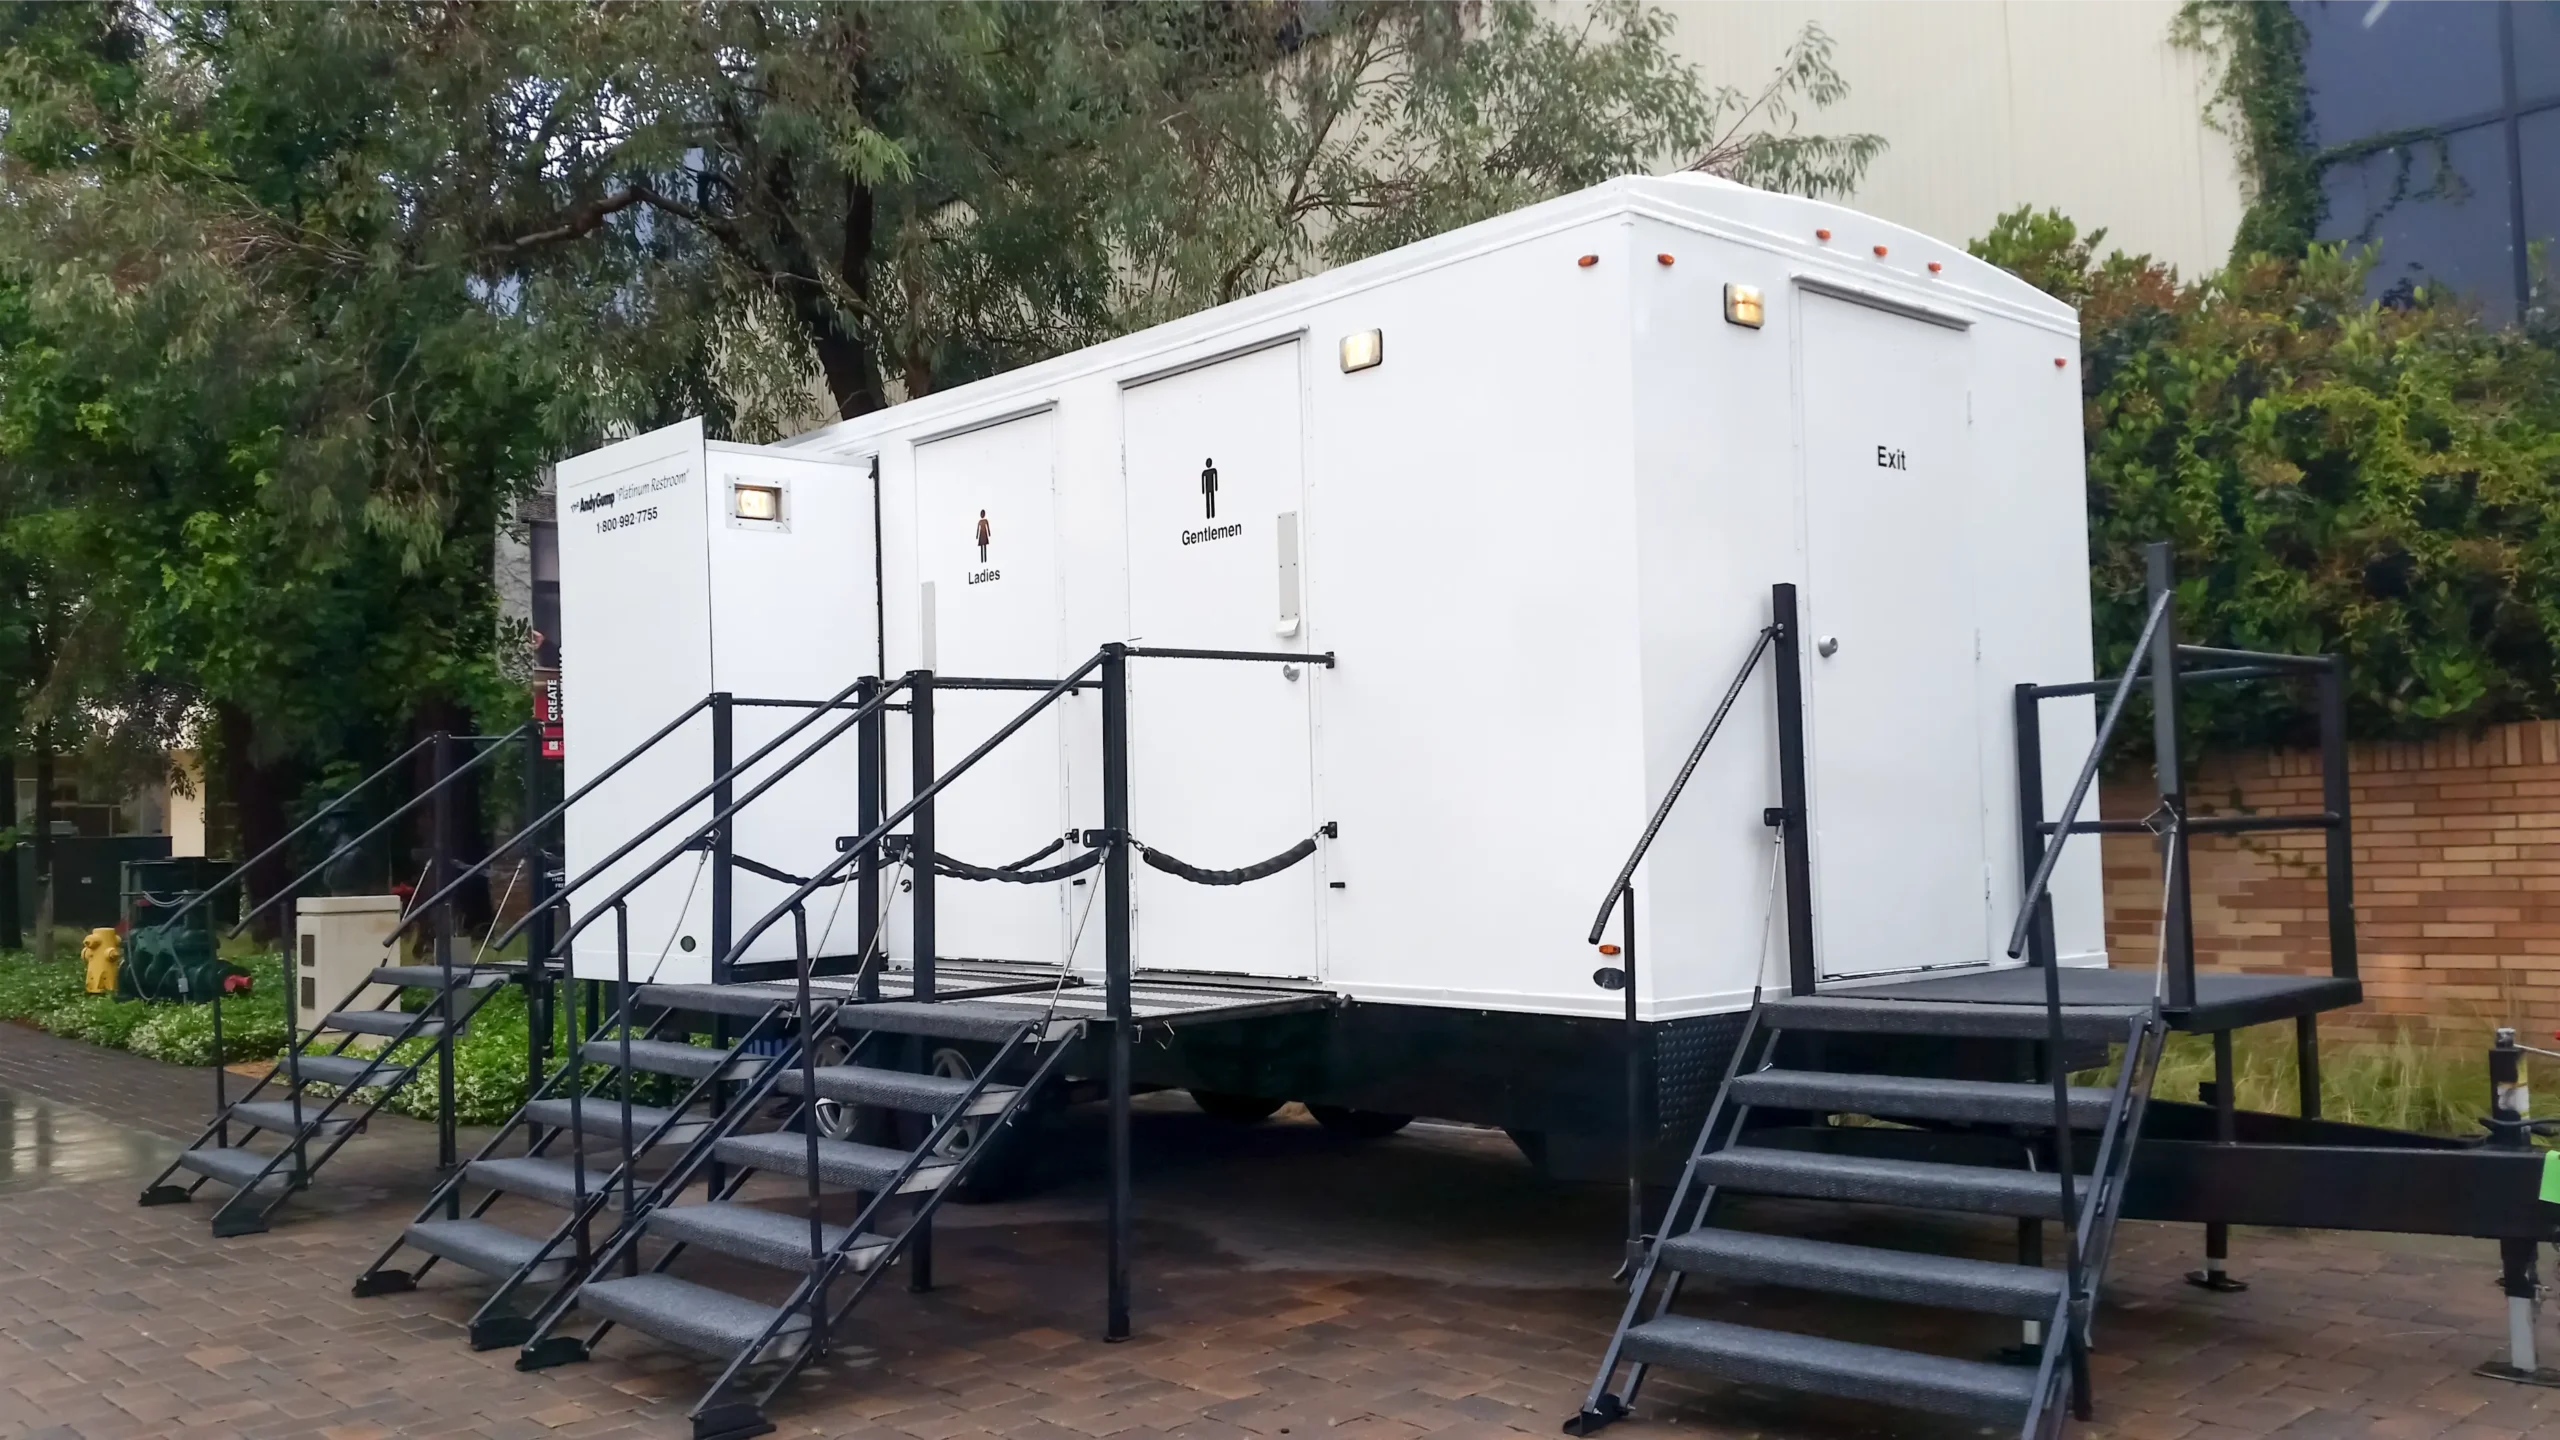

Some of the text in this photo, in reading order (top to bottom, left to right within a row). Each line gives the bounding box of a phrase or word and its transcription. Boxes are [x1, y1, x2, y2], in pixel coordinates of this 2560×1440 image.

[1877, 445, 1907, 471] Exit
[1181, 523, 1242, 546] Gentlemen
[968, 568, 1001, 585] Ladies
[547, 679, 558, 722] CREATE
